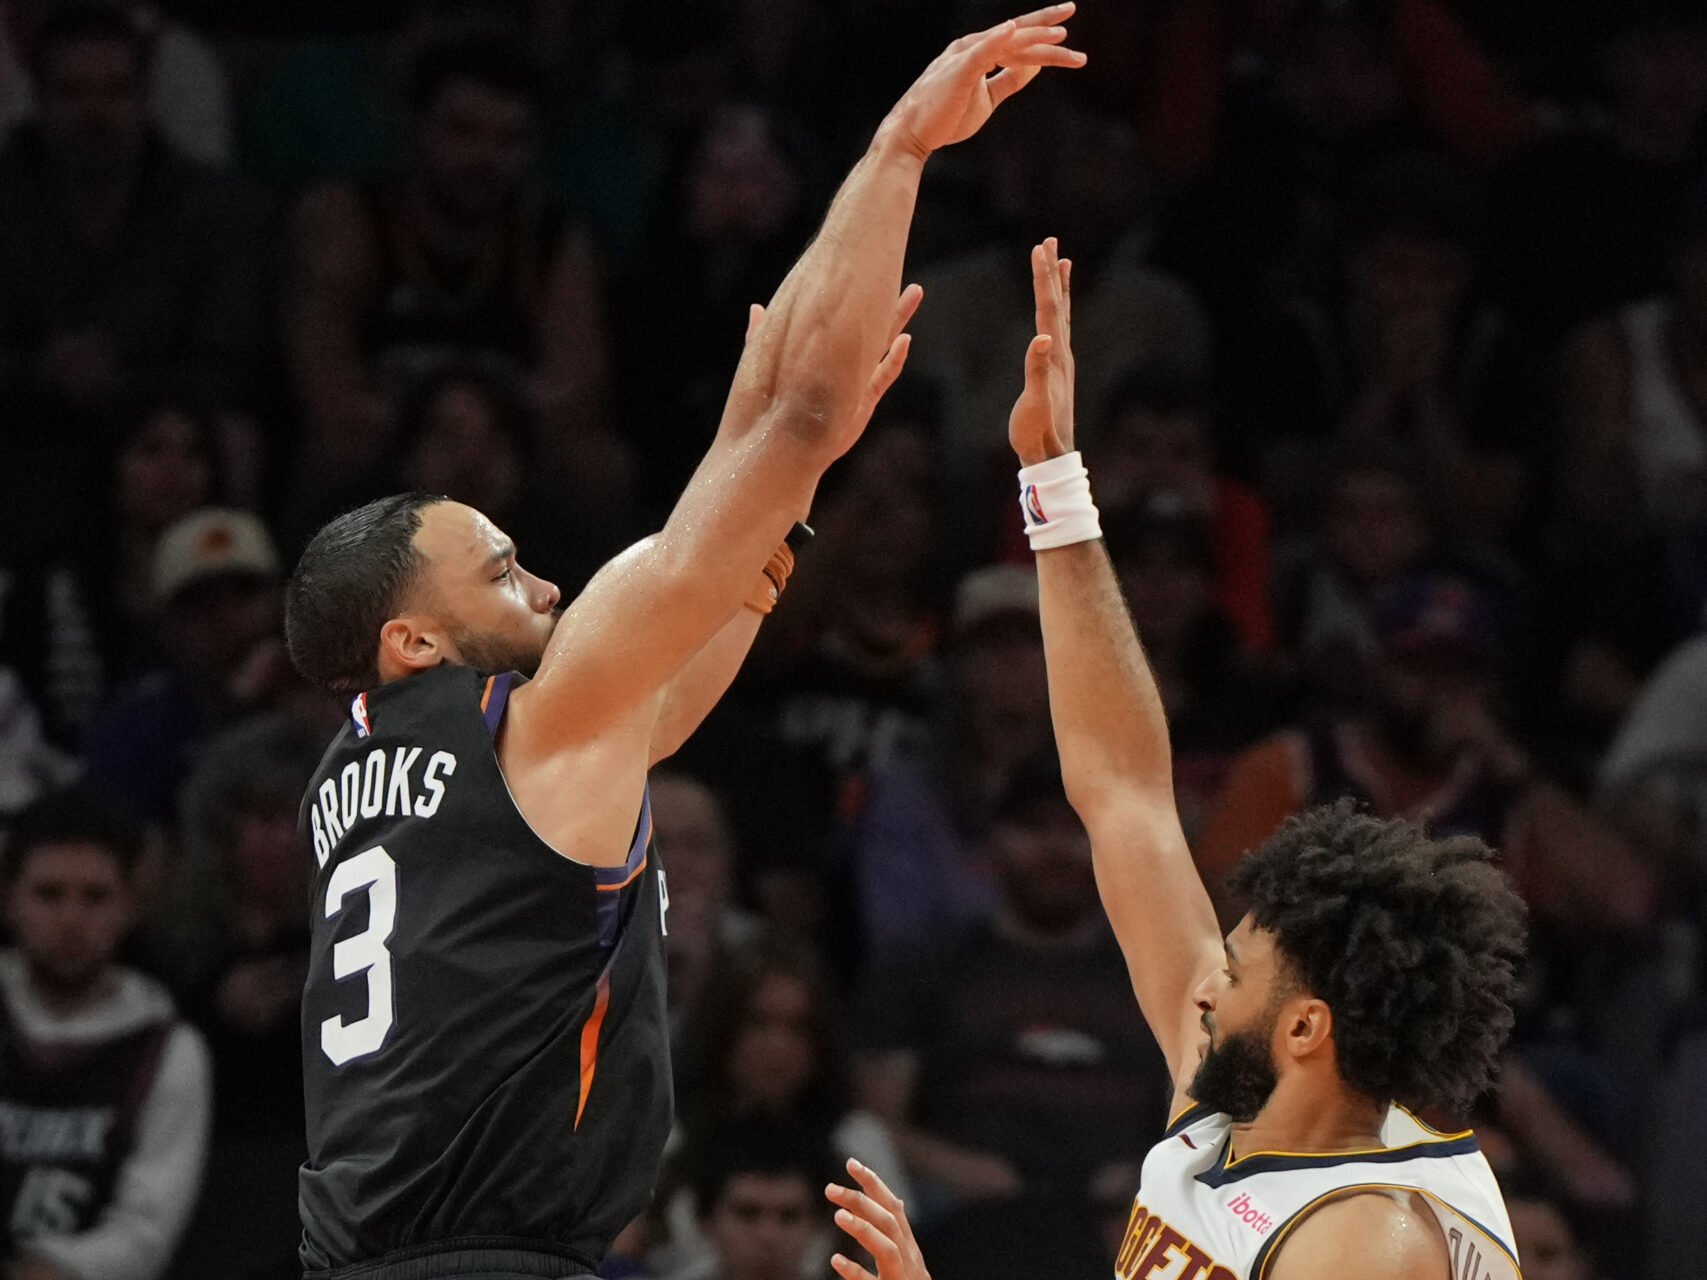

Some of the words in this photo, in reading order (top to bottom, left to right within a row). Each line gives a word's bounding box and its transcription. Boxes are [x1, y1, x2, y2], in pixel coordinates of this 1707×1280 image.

[312, 746, 456, 869] BROOKS
[321, 845, 398, 1067] 3
[1227, 1192, 1273, 1235] ibotta
